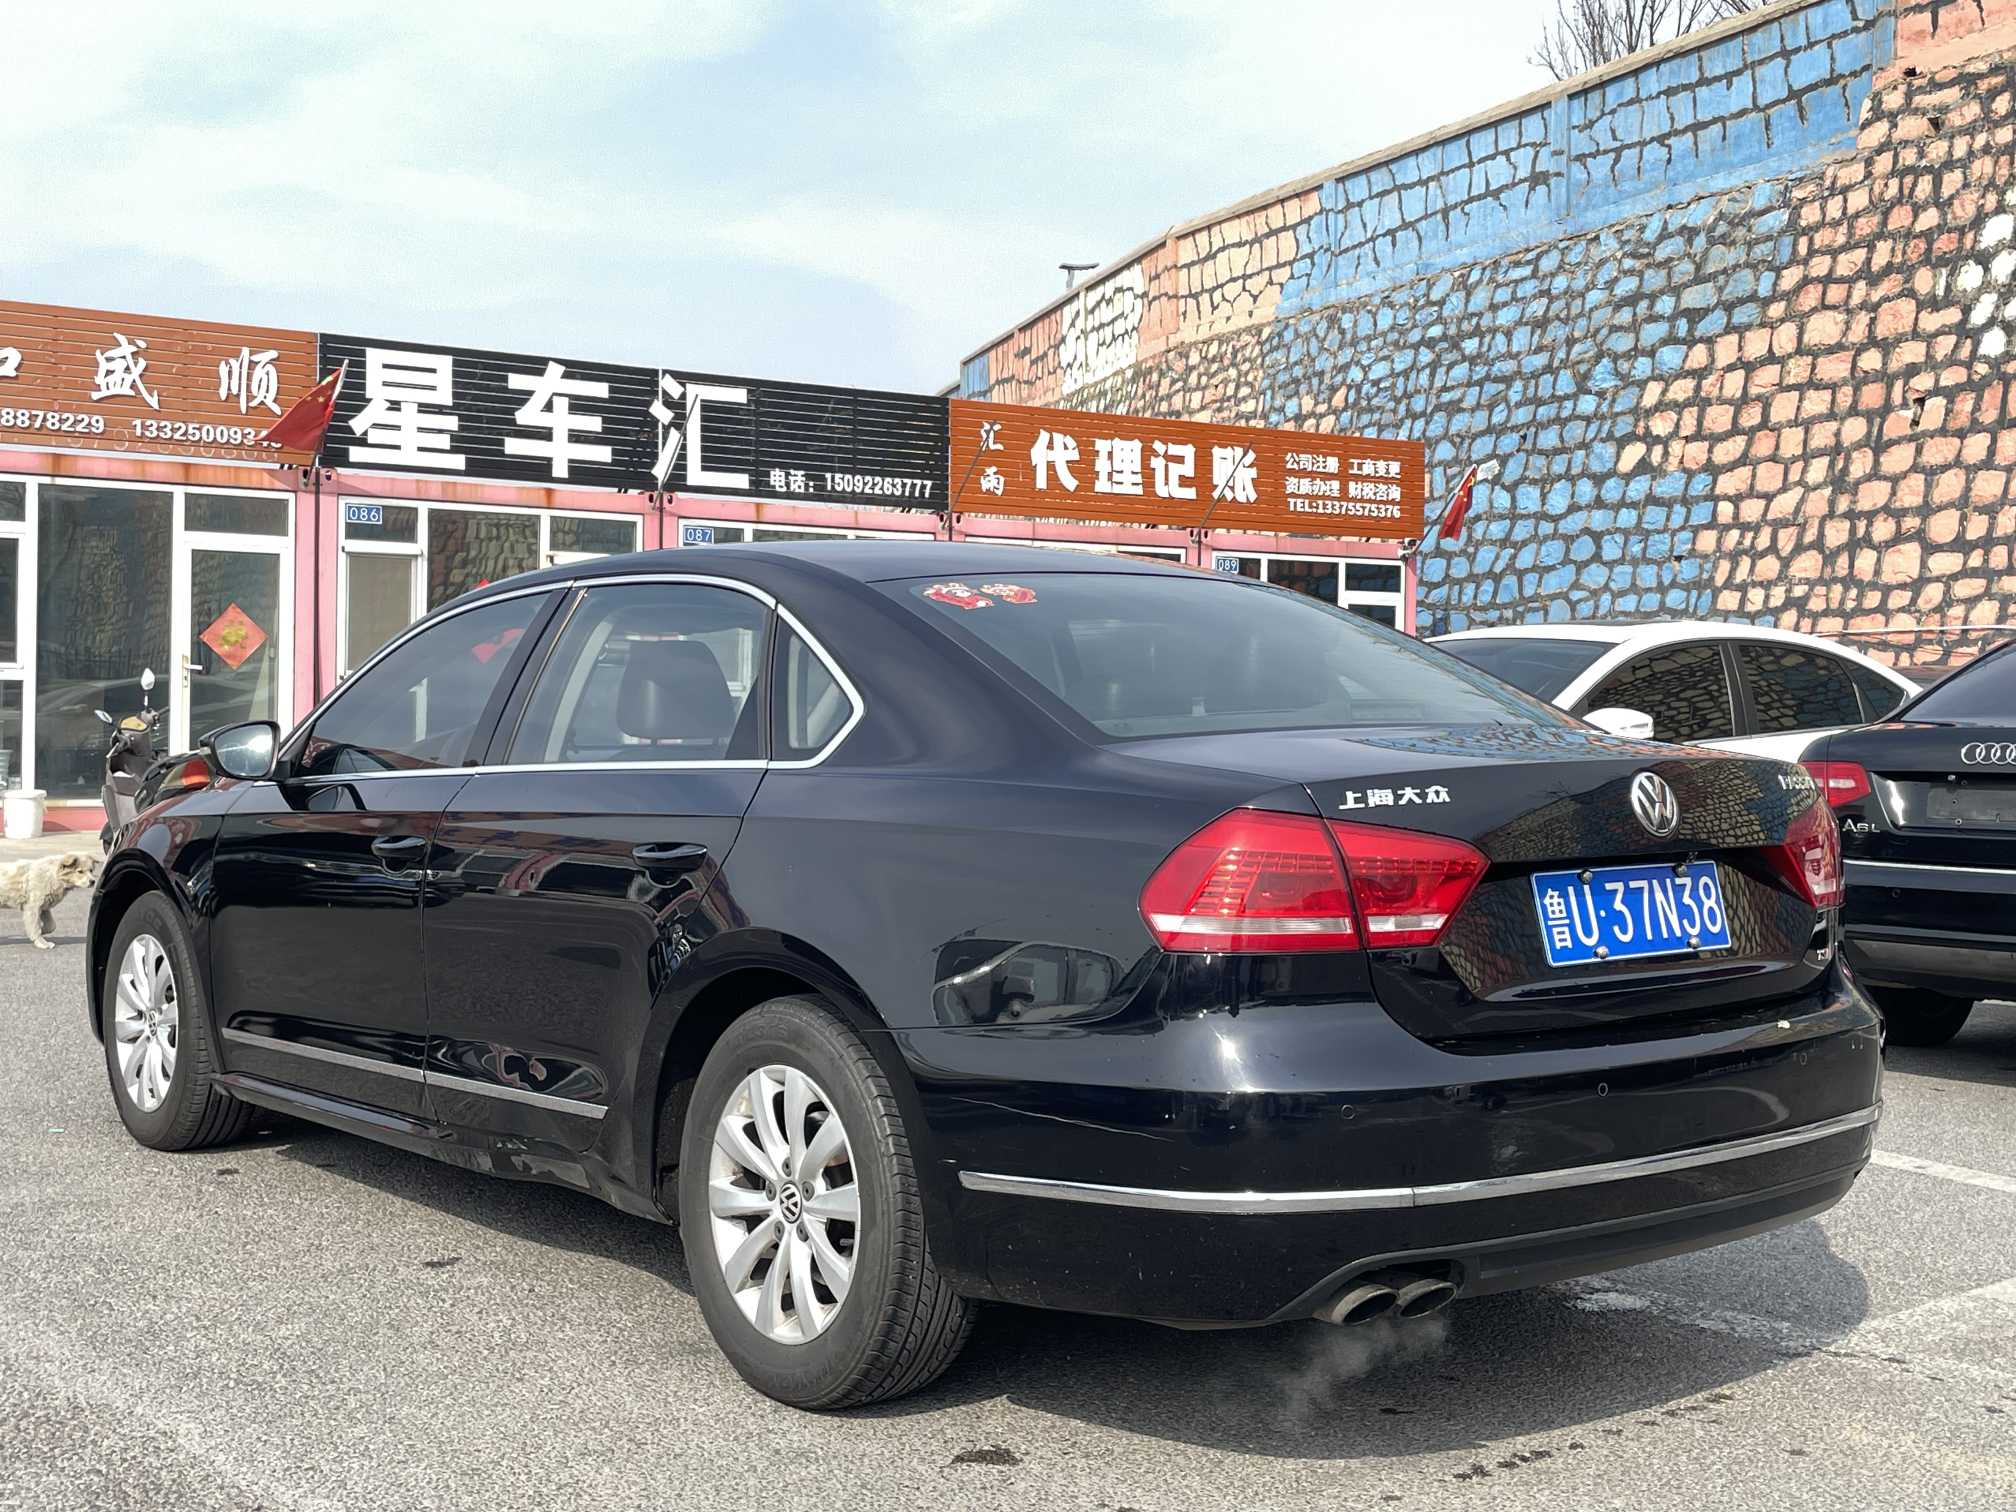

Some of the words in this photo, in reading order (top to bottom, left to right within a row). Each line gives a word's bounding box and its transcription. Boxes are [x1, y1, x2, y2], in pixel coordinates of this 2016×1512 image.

[1, 407, 105, 434] 8878229
[348, 347, 750, 490] 星车汇
[1030, 428, 1258, 504] 代理记账
[1285, 452, 1340, 474] 公司注册
[1348, 459, 1402, 478] 工商变更
[825, 472, 933, 499] 15092263777
[1285, 476, 1341, 497] 资质办理
[1348, 481, 1401, 502] 财税咨询
[350, 507, 379, 521] 086
[1287, 498, 1401, 518] TEL:13375575376
[687, 529, 711, 541] 087
[1218, 559, 1237, 571] 089
[1338, 785, 1451, 810] 上海大众
[1842, 819, 1881, 833] A6L
